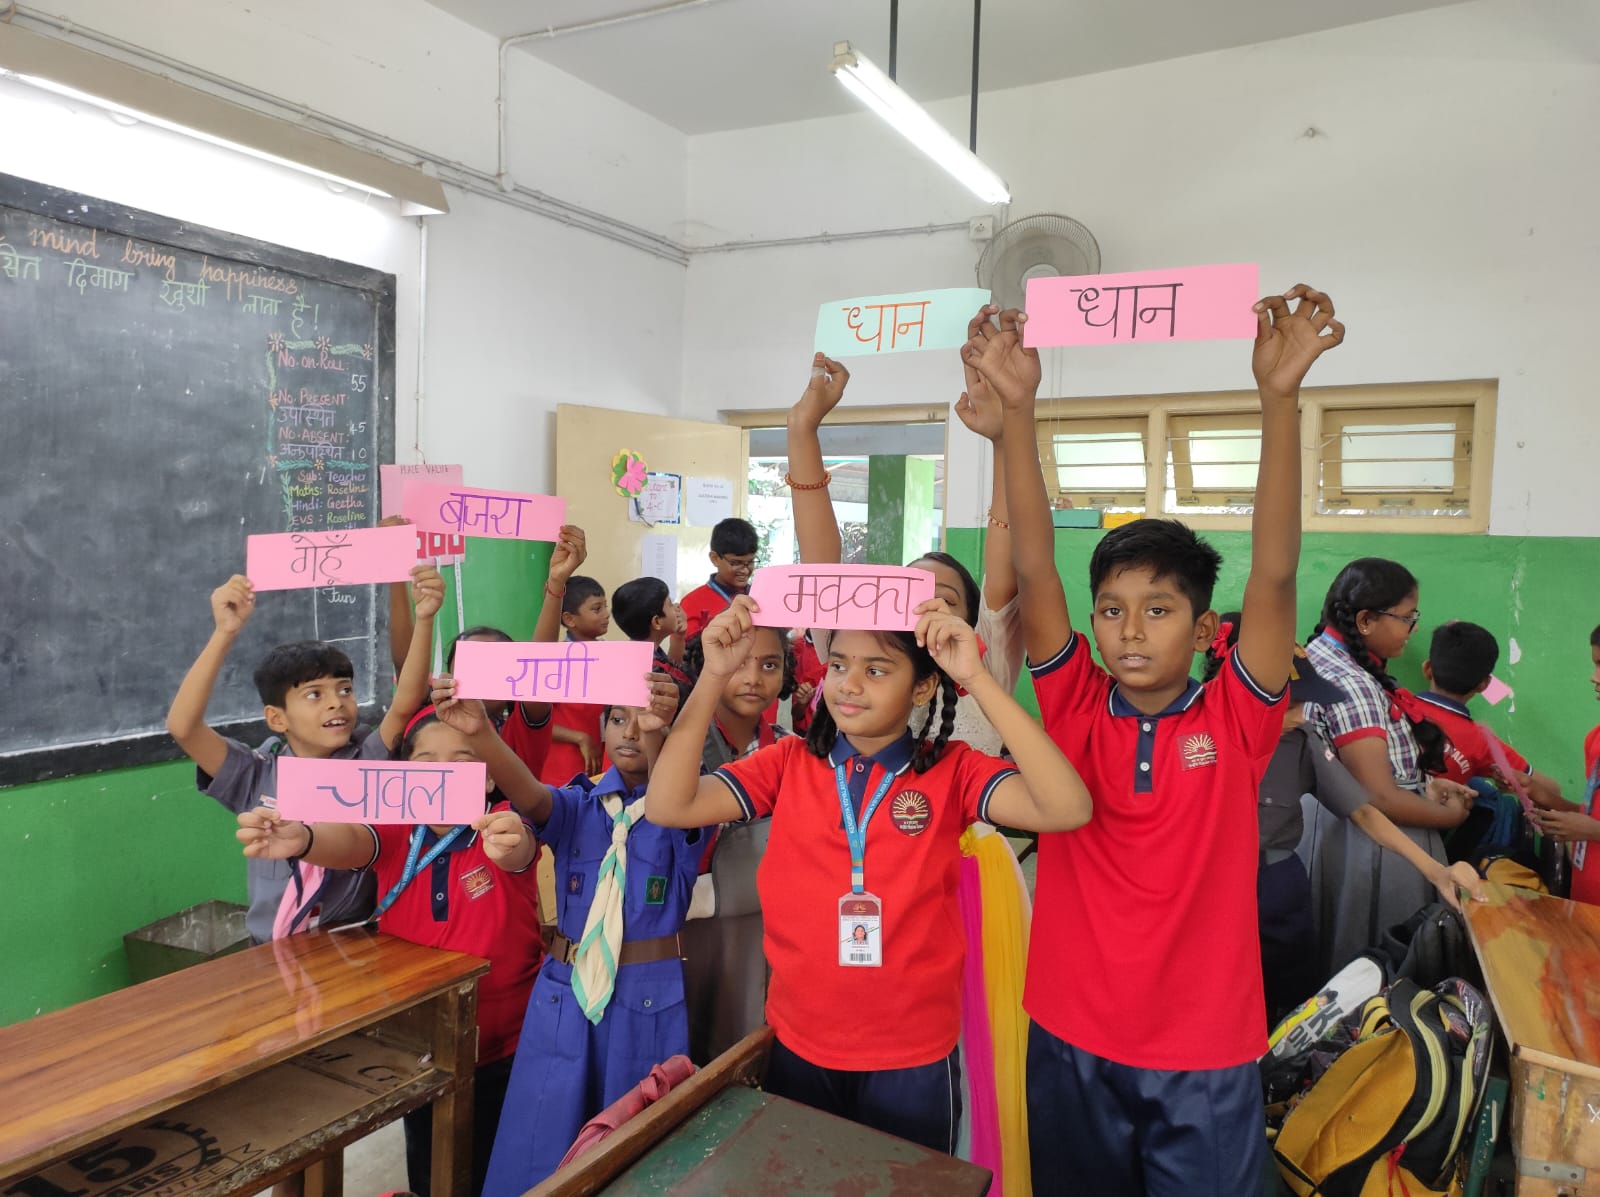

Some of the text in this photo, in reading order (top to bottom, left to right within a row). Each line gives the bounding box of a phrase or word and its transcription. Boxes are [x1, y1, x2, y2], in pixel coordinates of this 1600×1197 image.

[29, 228, 100, 259] mind
[121, 240, 176, 281] bring
[63, 258, 135, 295] दिमाग
[160, 279, 211, 313] खुशी
[242, 294, 282, 316] लाता
[1069, 282, 1184, 339] धान
[842, 300, 932, 352] धान
[351, 373, 368, 392] 55
[506, 641, 599, 698] रागी
[316, 767, 454, 821] चावल
